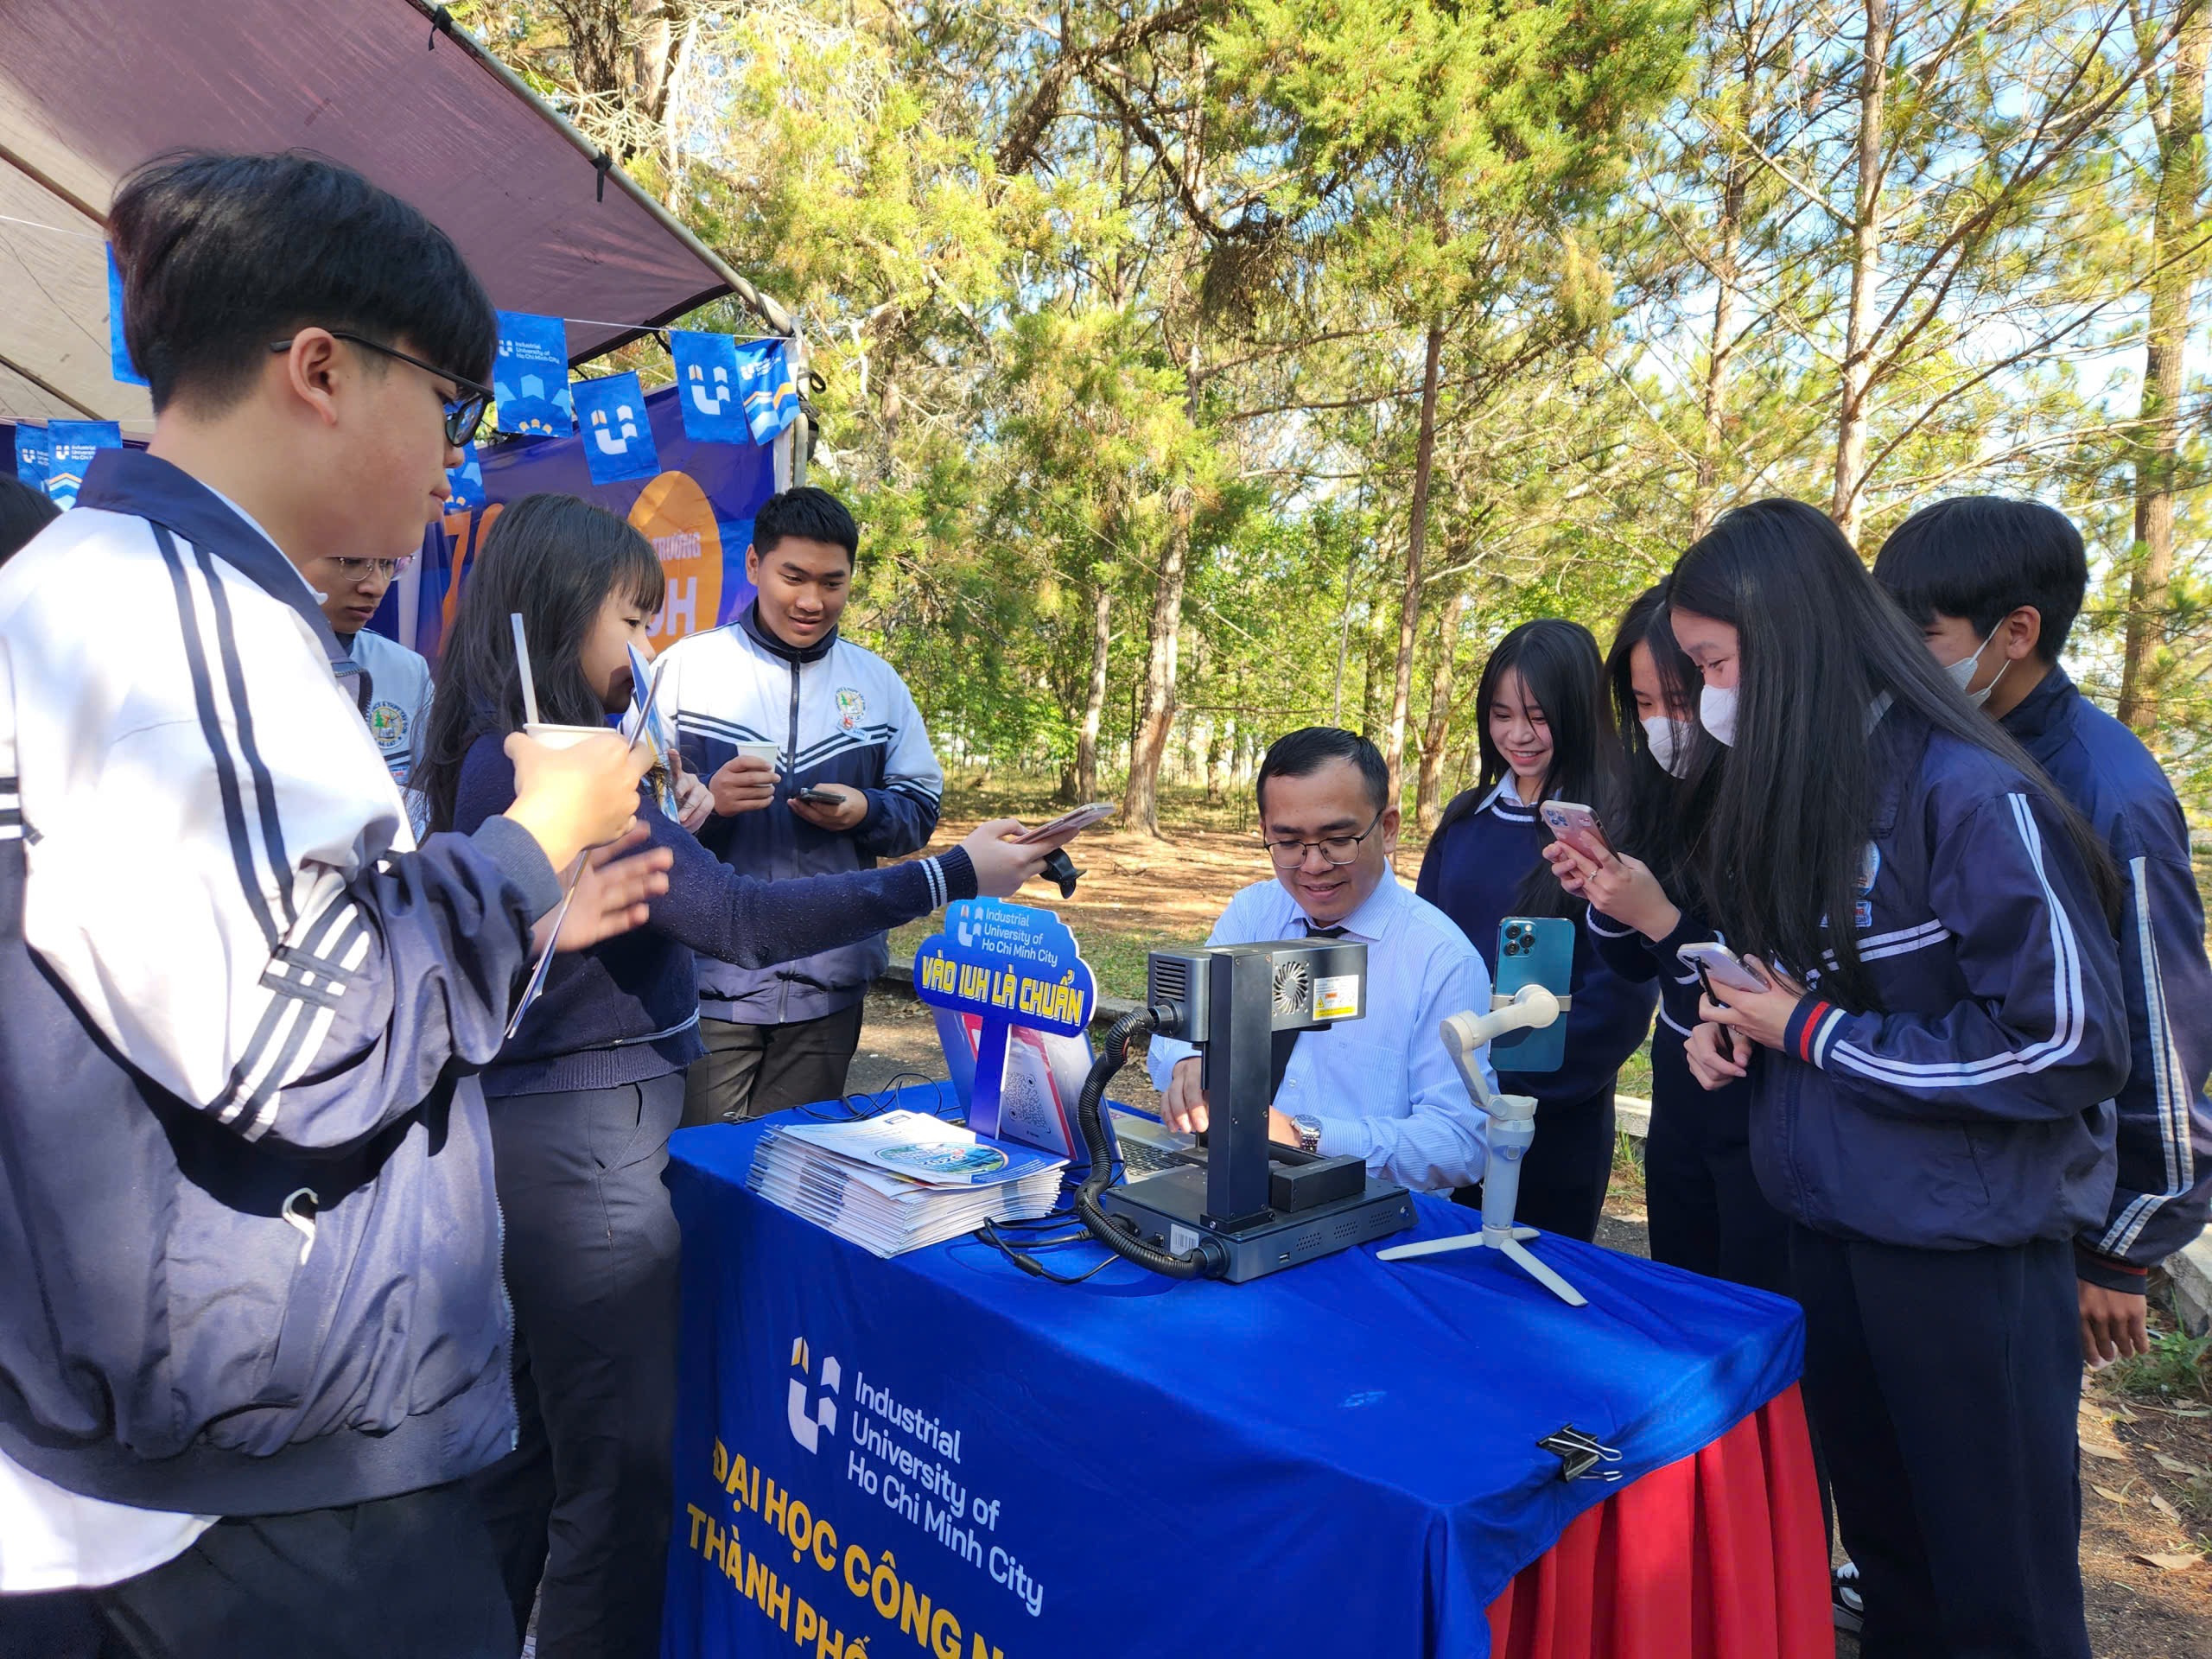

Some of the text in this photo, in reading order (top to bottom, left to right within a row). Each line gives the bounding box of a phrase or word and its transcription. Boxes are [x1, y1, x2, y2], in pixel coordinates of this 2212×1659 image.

[982, 938, 1058, 968] Ho Chi Minh City
[984, 923, 1044, 946] University of
[986, 907, 1030, 927] Industrial
[921, 949, 1085, 1027] VÀO IUH LÀ CHUẨN
[855, 1371, 961, 1465] Industrial
[852, 1410, 1001, 1532] University of
[687, 1502, 791, 1633] THÀNH
[712, 1435, 962, 1659] ĐẠI HỌC CÔNG
[848, 1450, 1044, 1618] Ho Chi Minh City
